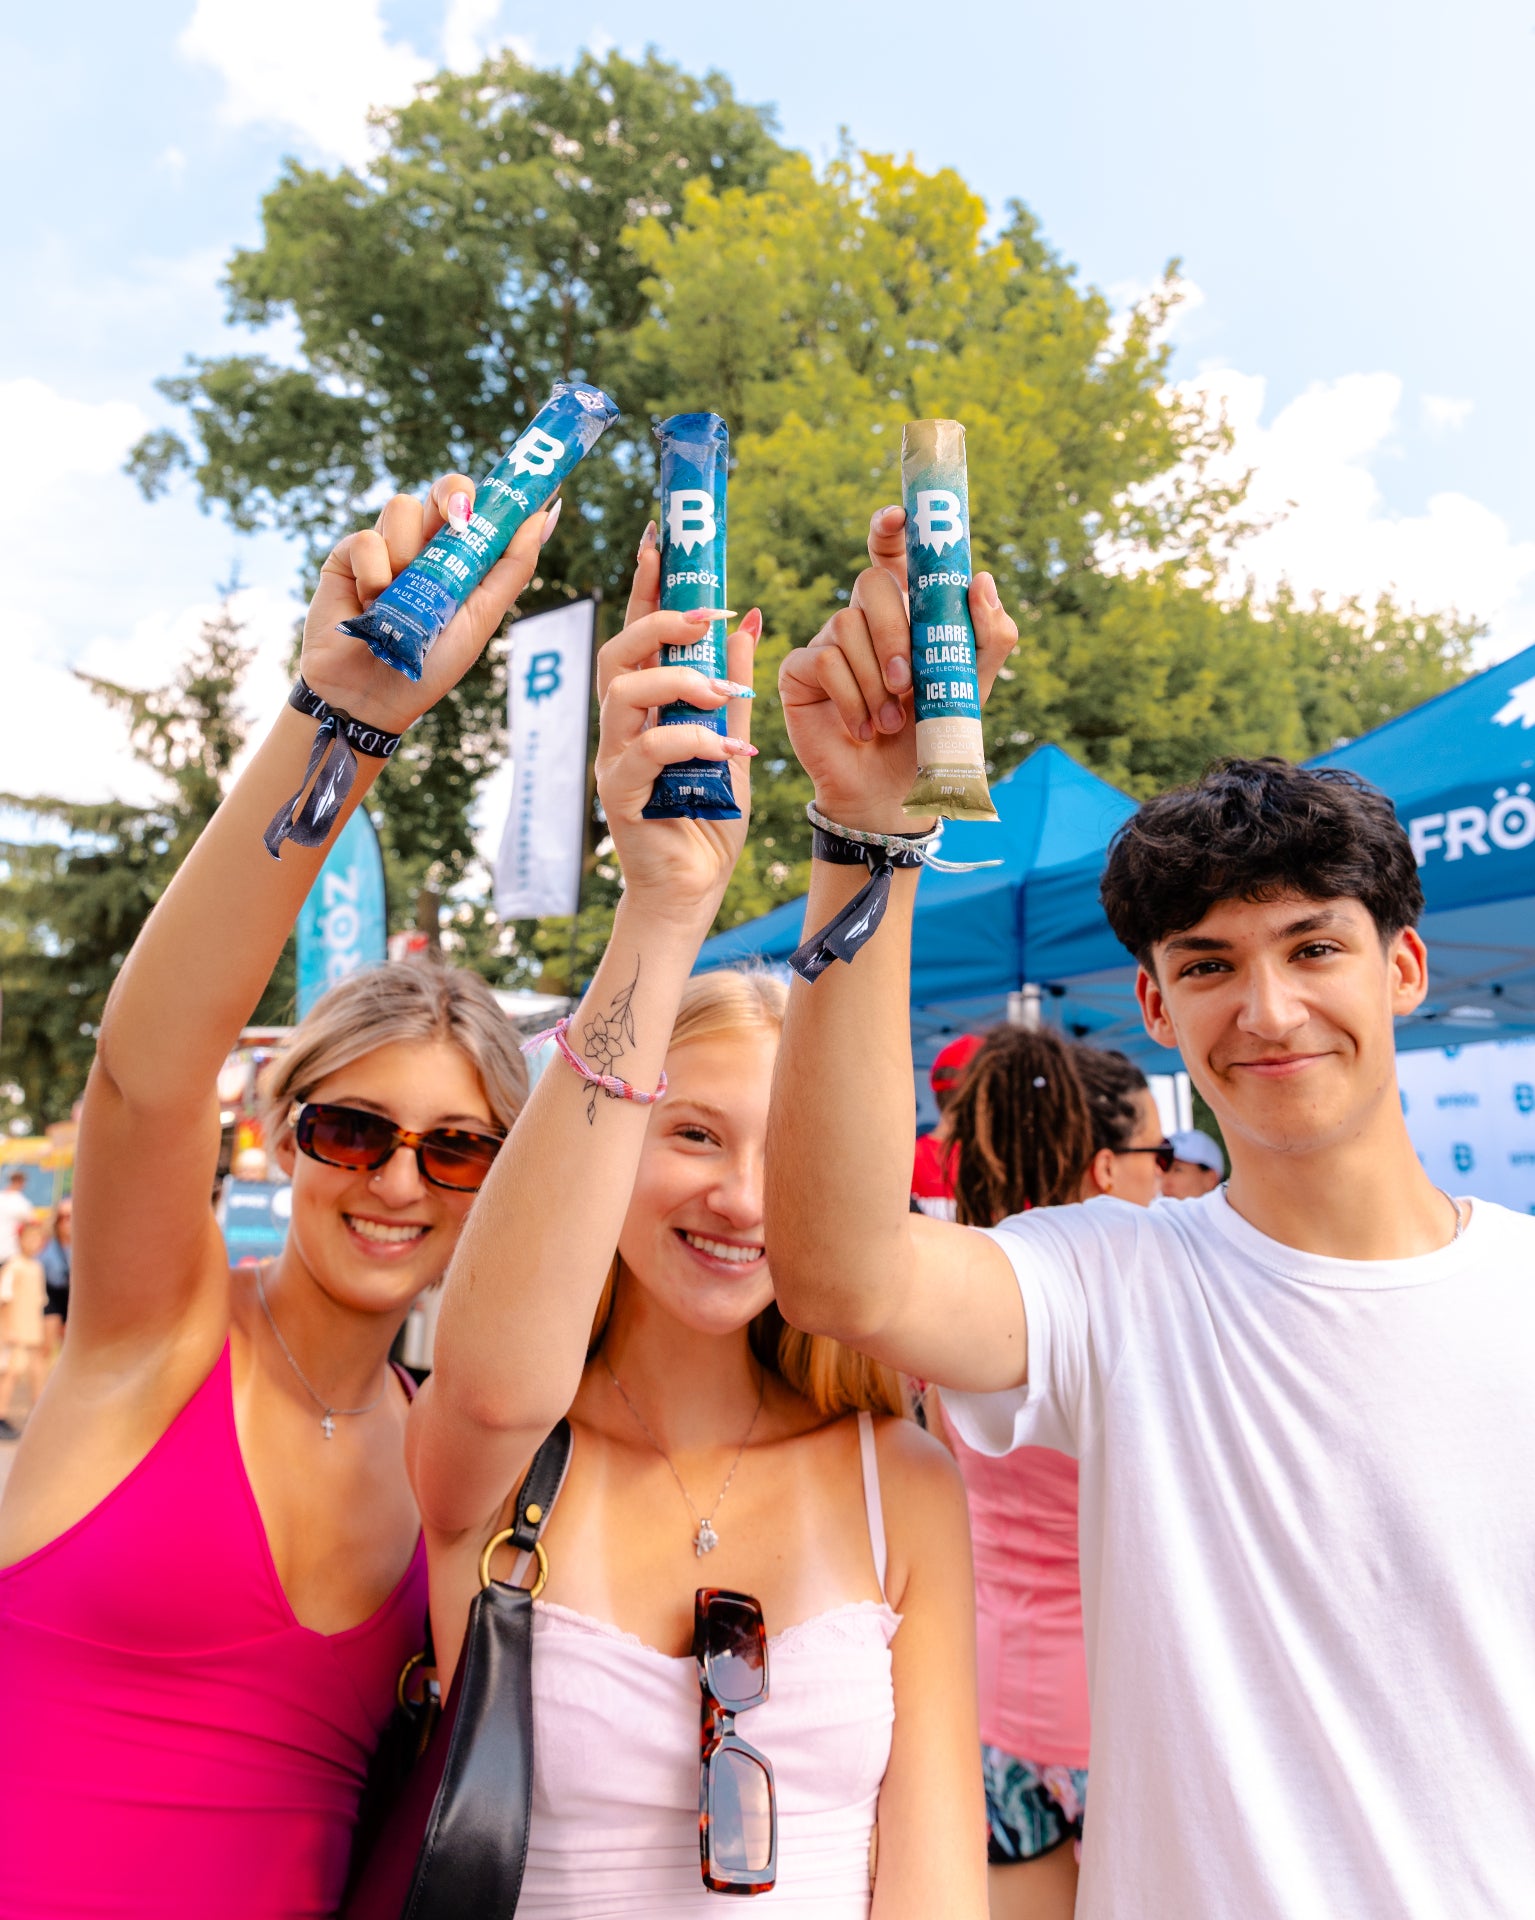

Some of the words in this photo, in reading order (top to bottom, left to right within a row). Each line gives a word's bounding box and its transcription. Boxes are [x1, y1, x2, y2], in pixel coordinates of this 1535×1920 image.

[507, 426, 565, 476] B
[483, 477, 530, 512] BFRÖZ
[469, 512, 499, 542] ARRE
[666, 489, 717, 557] B
[913, 489, 964, 558] B
[423, 547, 448, 562] ICE
[443, 554, 470, 582] BAR
[405, 572, 449, 602] FRAMBOISE
[410, 580, 437, 599] BLEUE
[666, 569, 720, 589] BFRÖZ
[918, 570, 969, 590] BFRÖZ
[392, 587, 414, 600] BLUE
[414, 598, 437, 618] RAZZ
[379, 621, 393, 635] 110
[392, 630, 404, 642] ml
[926, 625, 968, 643] BARRE
[668, 641, 717, 664] GLACÉE
[925, 643, 972, 665] GLACÉE
[525, 650, 563, 705] B
[919, 666, 935, 676] AVEC
[926, 682, 947, 701] ICE
[950, 681, 974, 700] BAR
[921, 702, 936, 711] WITH
[930, 742, 975, 750] COCONUT
[678, 785, 692, 796] 110
[692, 785, 705, 796] ml
[940, 785, 953, 795] 110
[1409, 782, 1535, 869] FRÖ
[317, 865, 362, 986] RÖZ
